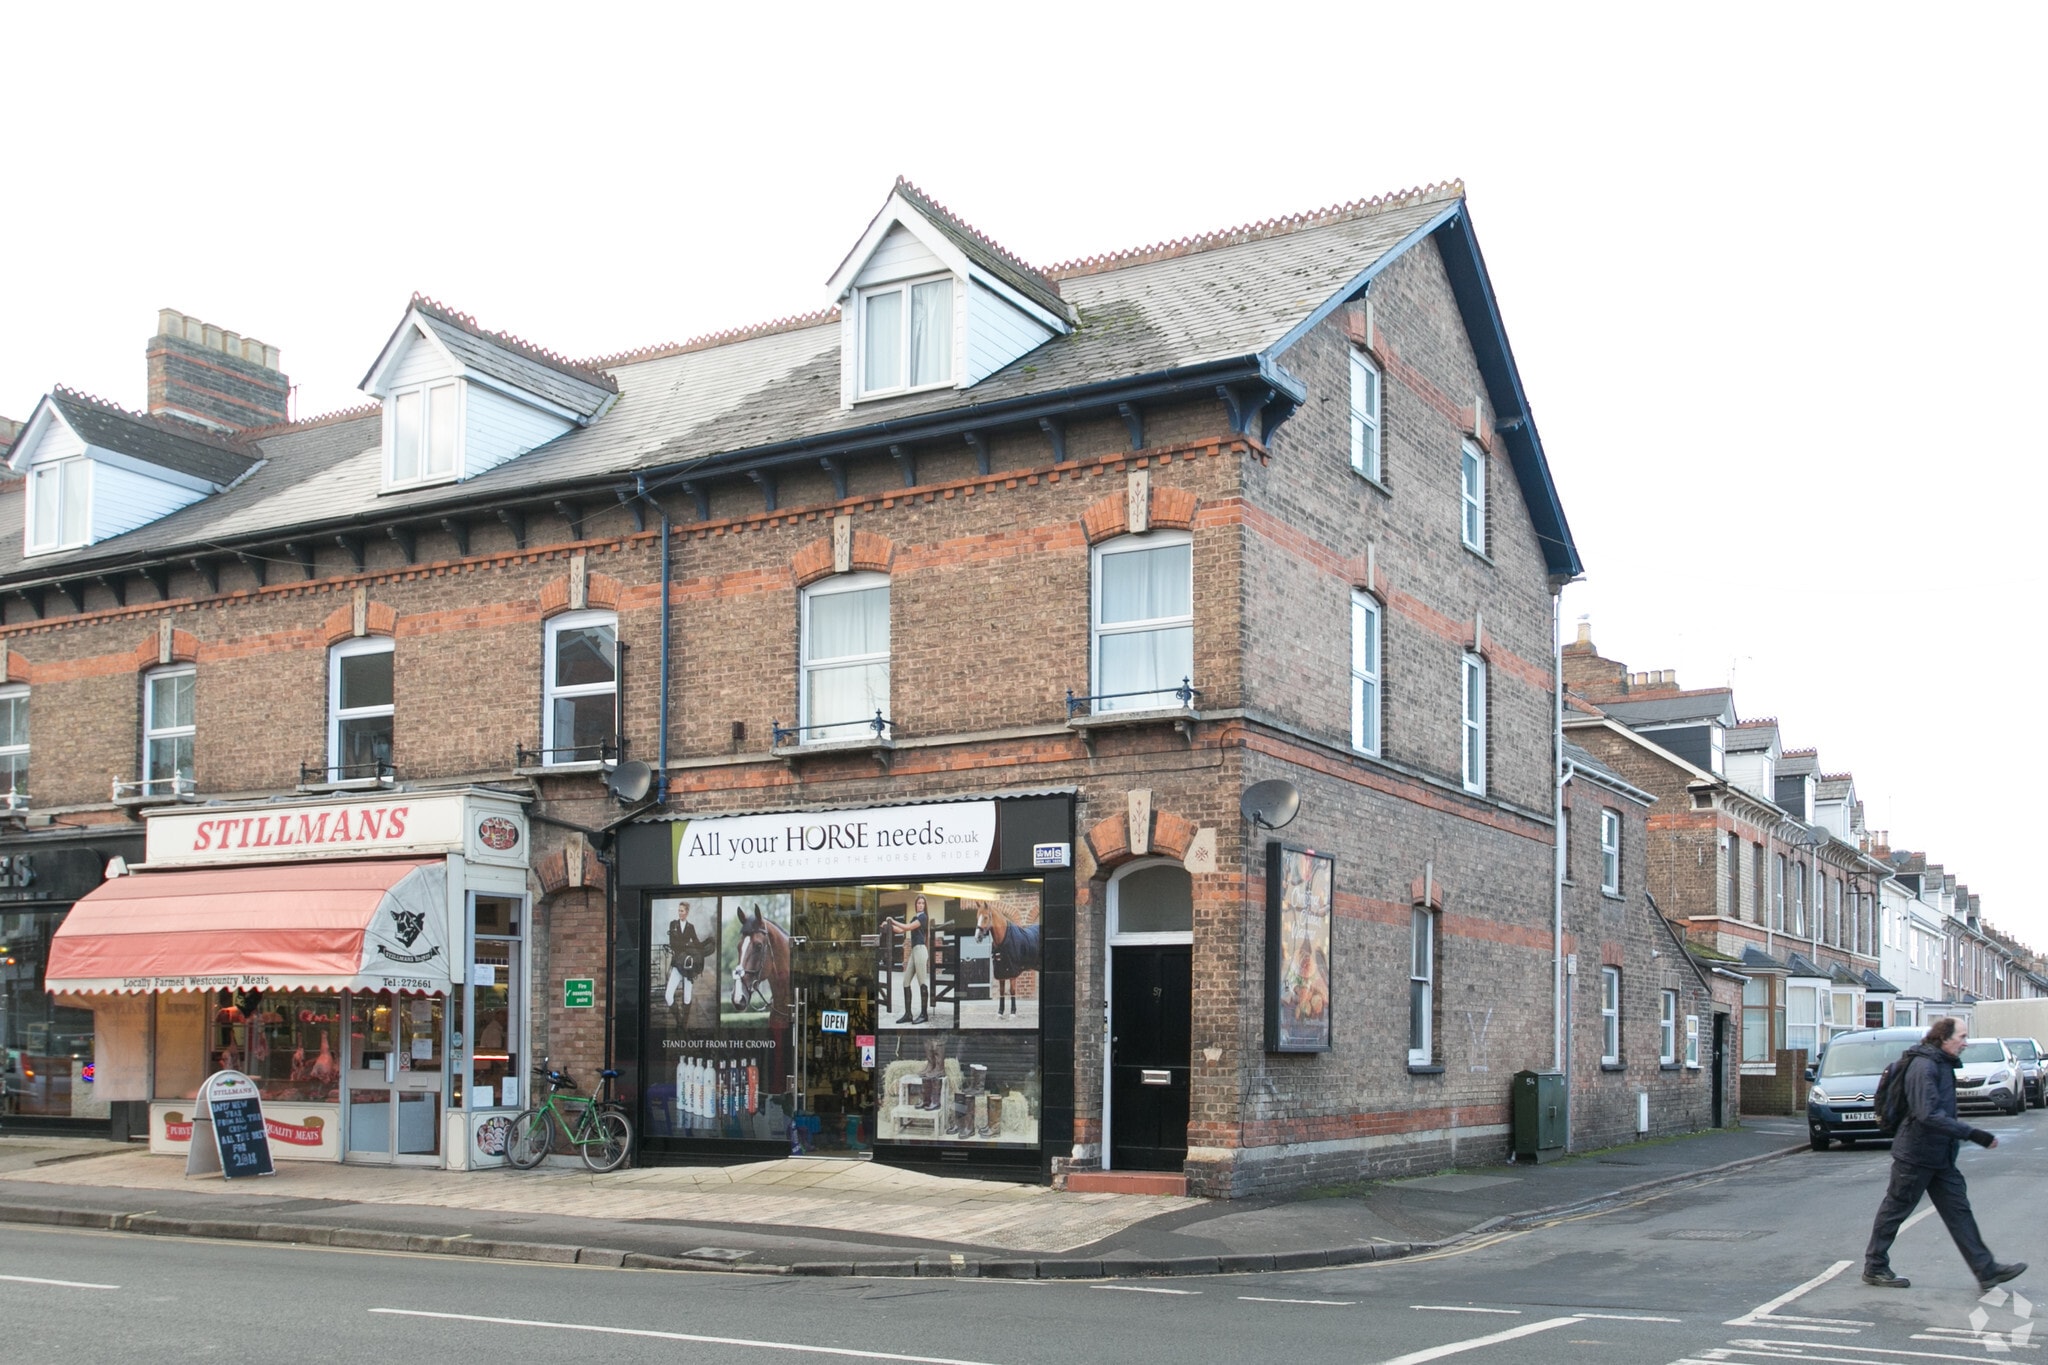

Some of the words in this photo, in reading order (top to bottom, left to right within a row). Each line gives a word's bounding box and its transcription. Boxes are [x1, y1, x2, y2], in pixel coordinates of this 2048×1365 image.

[193, 807, 409, 850] STILLMANS
[688, 832, 721, 857] All
[728, 836, 778, 862] your
[786, 822, 869, 851] HORSE
[741, 858, 810, 869] EQUIPMENT
[817, 857, 839, 865] FOR
[847, 855, 868, 863] THE
[877, 853, 917, 862] HORSE
[926, 853, 932, 861] &
[941, 850, 980, 859] RIDER
[123, 978, 150, 989] Locally
[154, 977, 185, 987] Farmed
[189, 976, 239, 988] Westcountry
[242, 975, 270, 985] Meats
[824, 1014, 846, 1029] OPEN
[662, 1040, 687, 1048] STAND
[687, 1040, 703, 1048] OUT
[705, 1040, 727, 1048] FROM
[729, 1040, 744, 1048] THE
[745, 1040, 776, 1048] CROWD
[213, 1088, 252, 1096] STILLMANS
[232, 1100, 248, 1109] NEW
[228, 1125, 248, 1133] CREW
[266, 1123, 294, 1139] QUALITY
[295, 1128, 319, 1140] MEATS
[221, 1135, 235, 1144] ALL
[235, 1132, 250, 1142] THE
[232, 1143, 247, 1153] FOR
[232, 1152, 258, 1167] 2018
